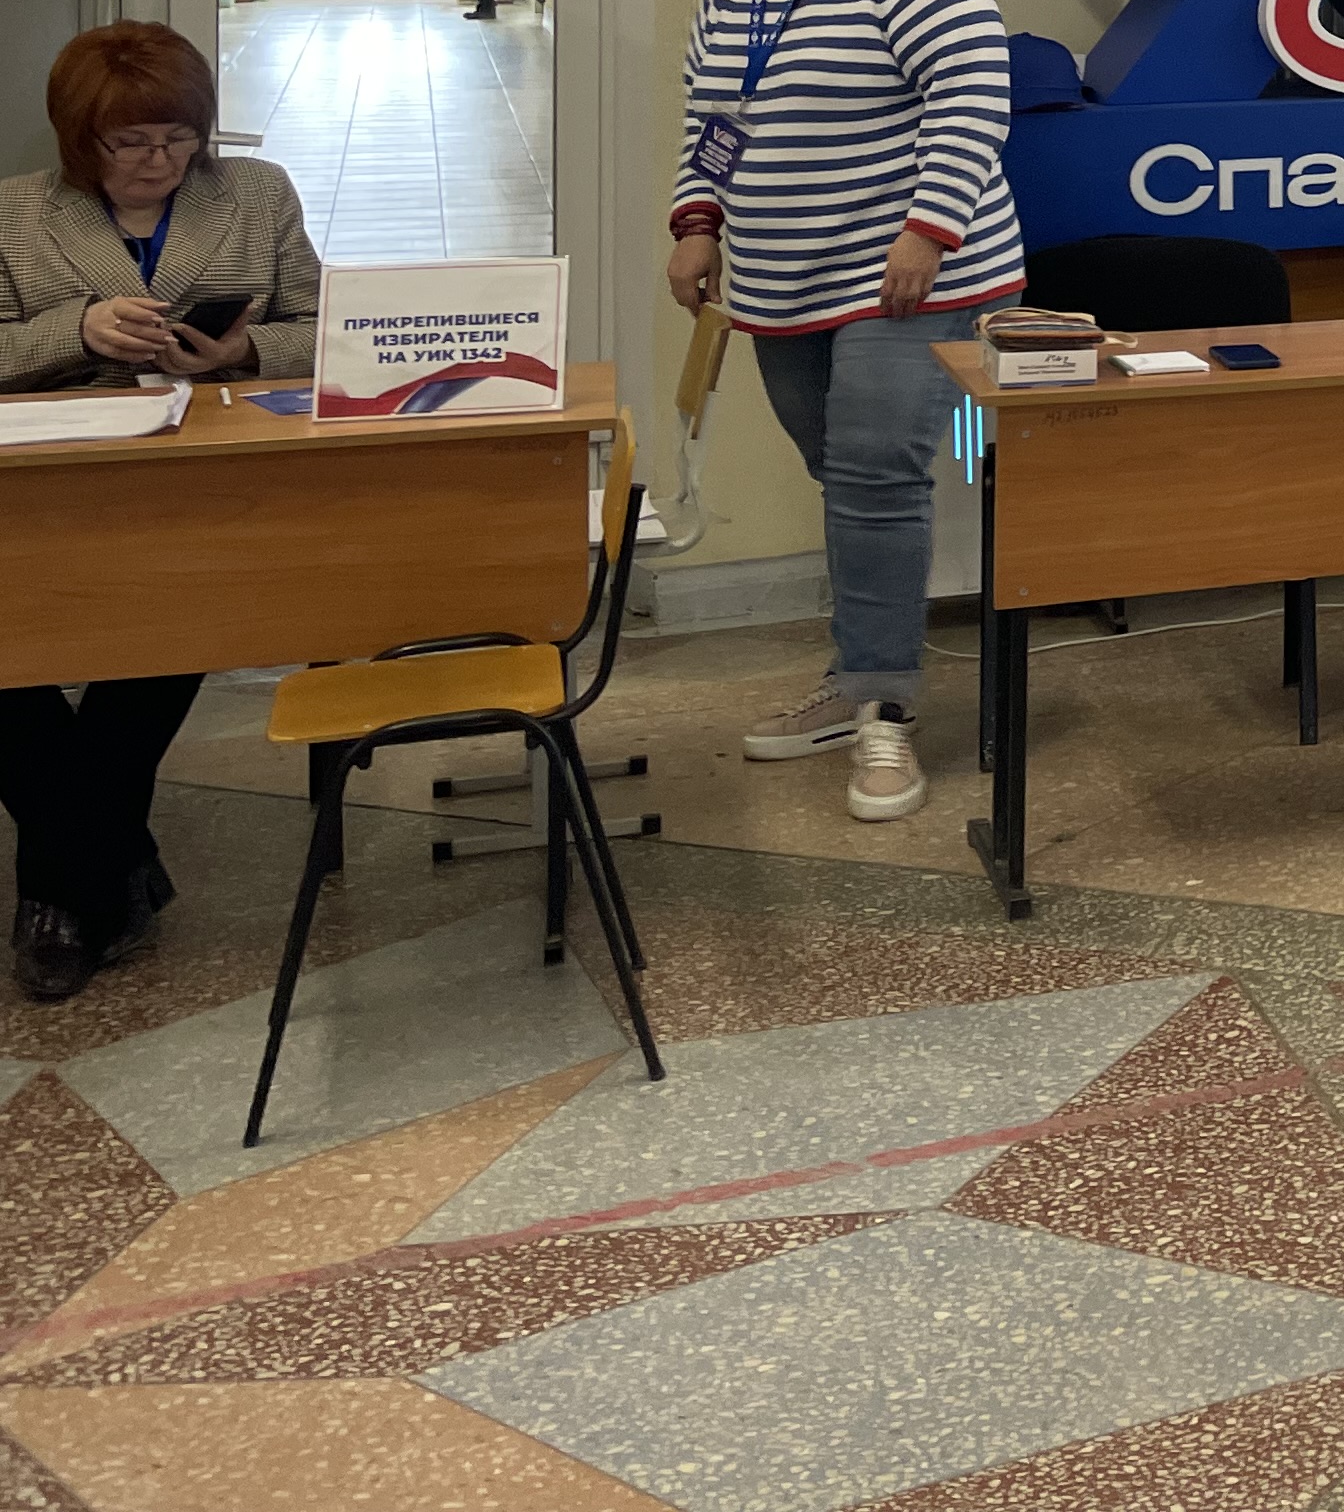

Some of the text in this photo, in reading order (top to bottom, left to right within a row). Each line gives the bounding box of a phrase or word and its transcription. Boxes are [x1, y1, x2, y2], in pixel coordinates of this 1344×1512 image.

[344, 311, 540, 331] ПРИКРЕПИВШИЕСЯ
[373, 330, 510, 347] ИЗБИРАТЕЛИ
[378, 348, 503, 364] НА УИК 1342
